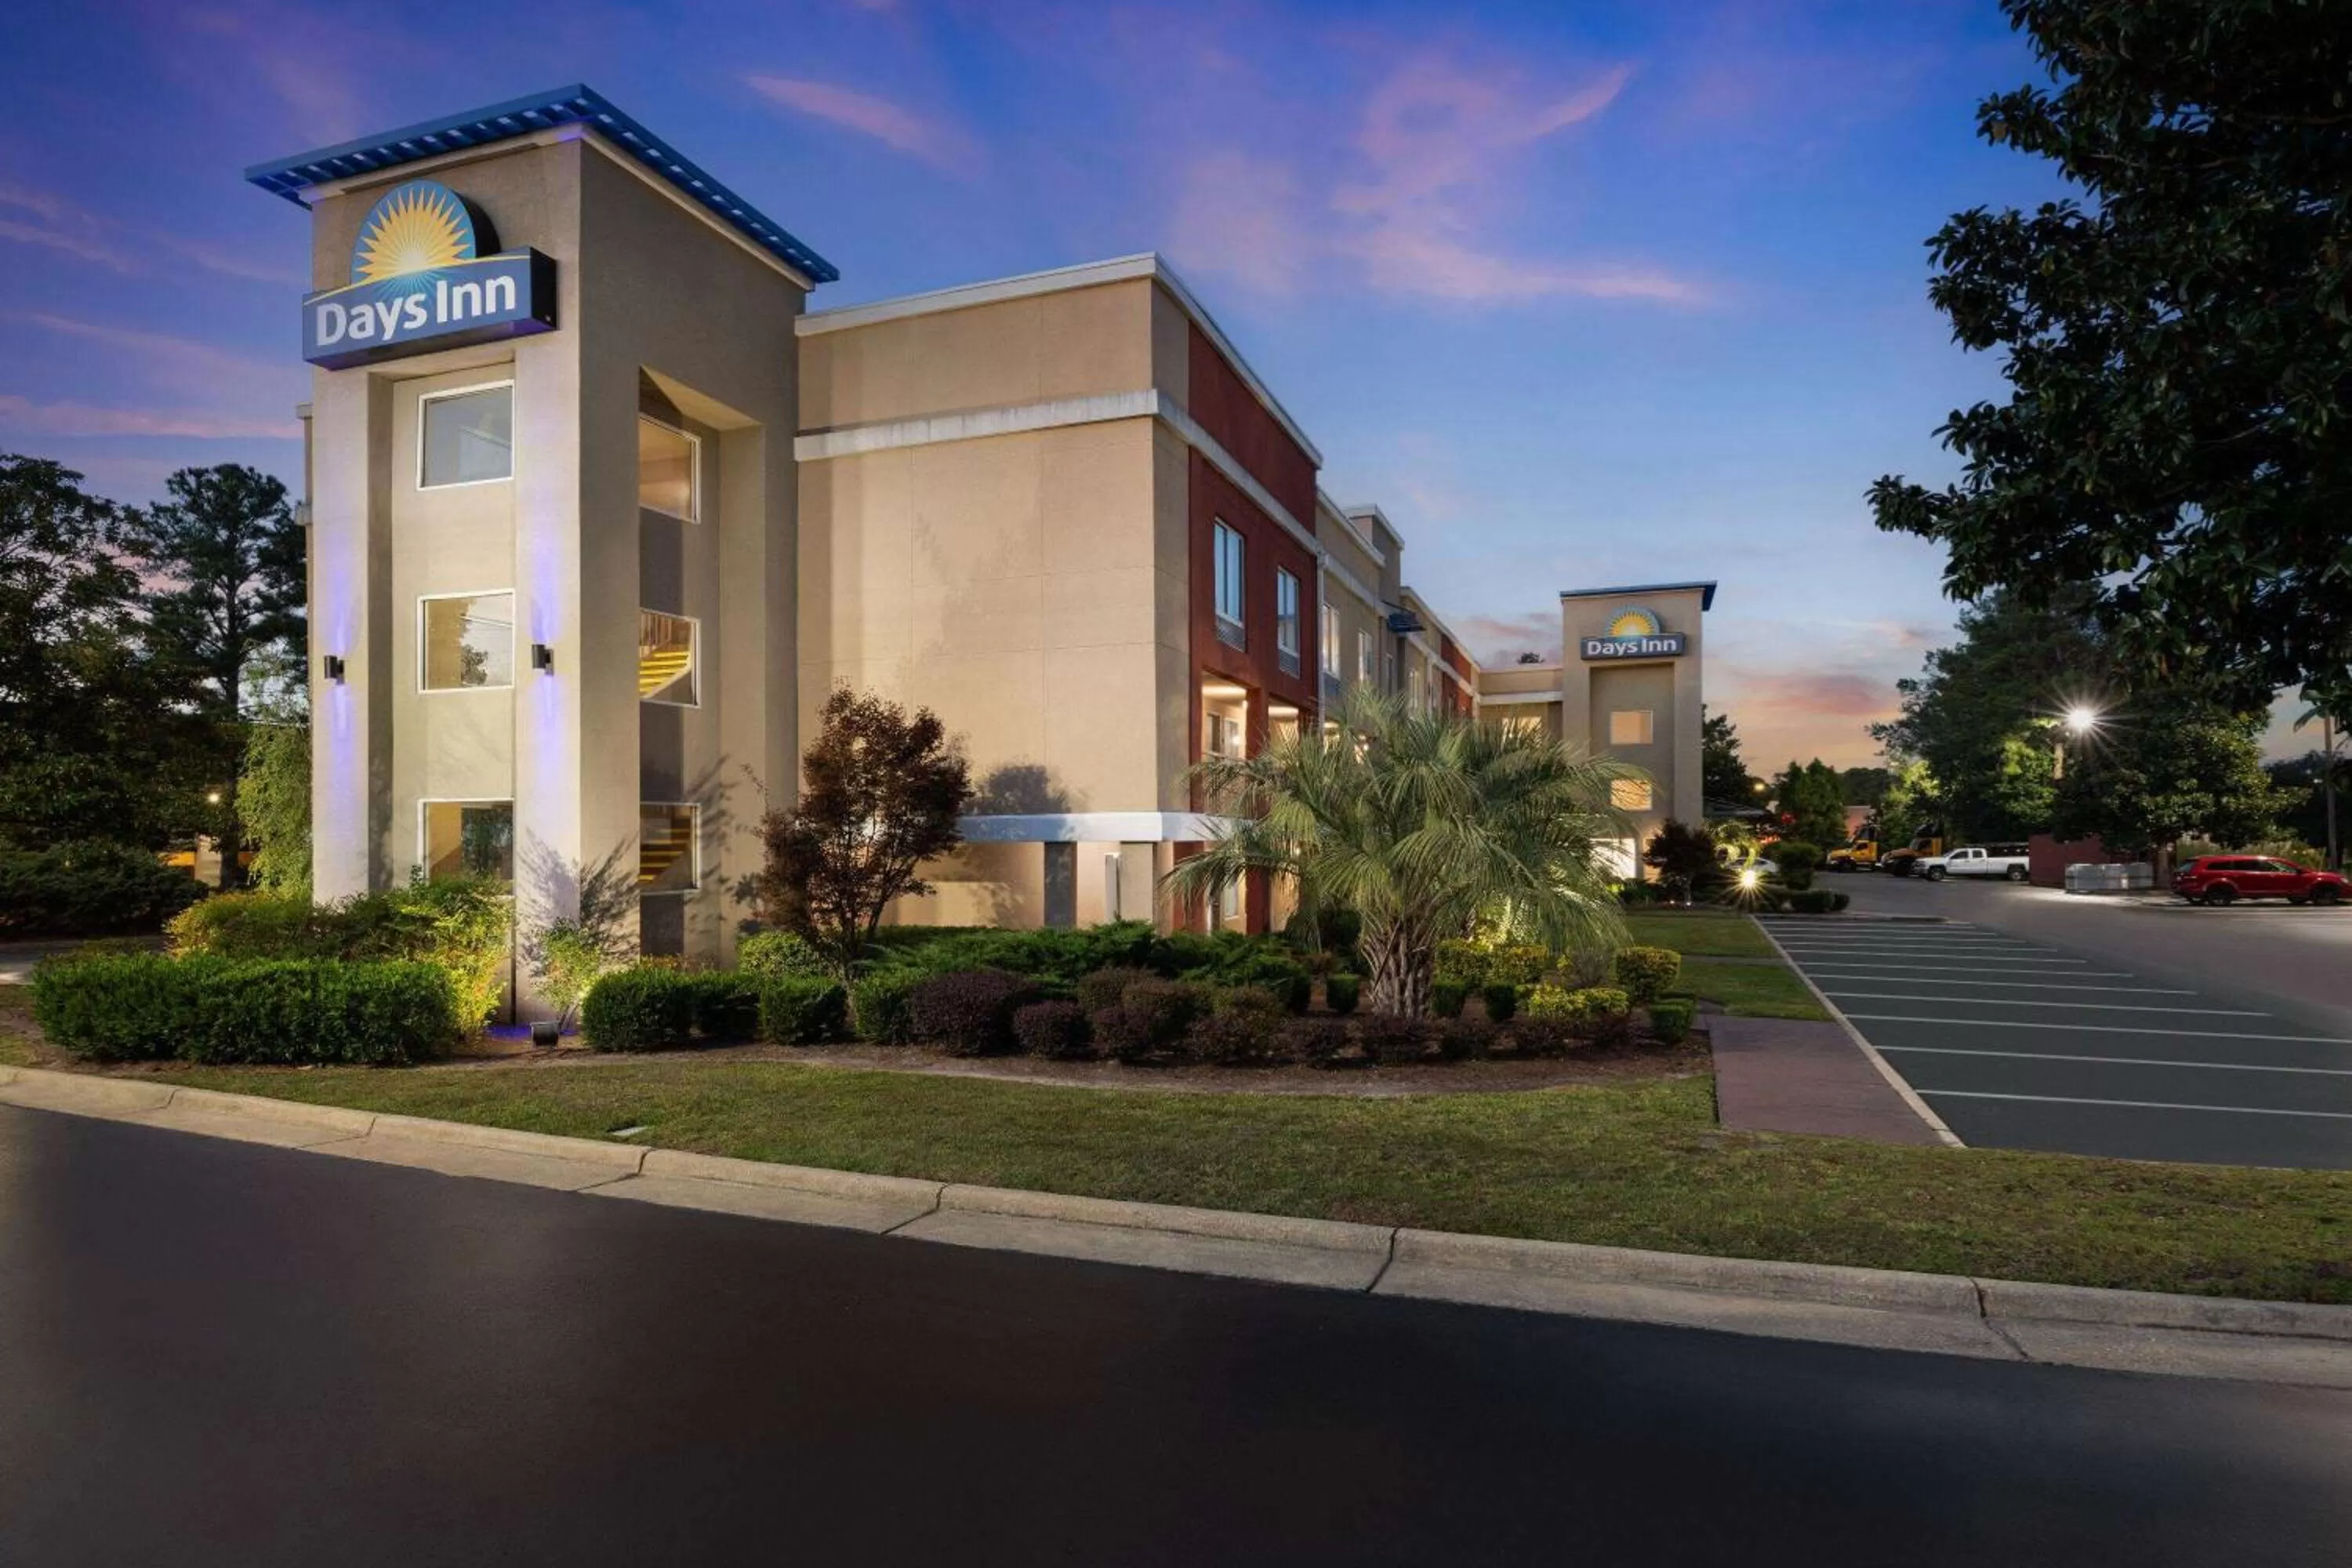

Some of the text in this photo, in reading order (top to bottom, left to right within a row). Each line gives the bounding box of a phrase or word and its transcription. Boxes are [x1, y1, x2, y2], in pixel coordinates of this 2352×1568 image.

[317, 275, 515, 346] Days Inn
[1587, 638, 1676, 656] Days Inn
